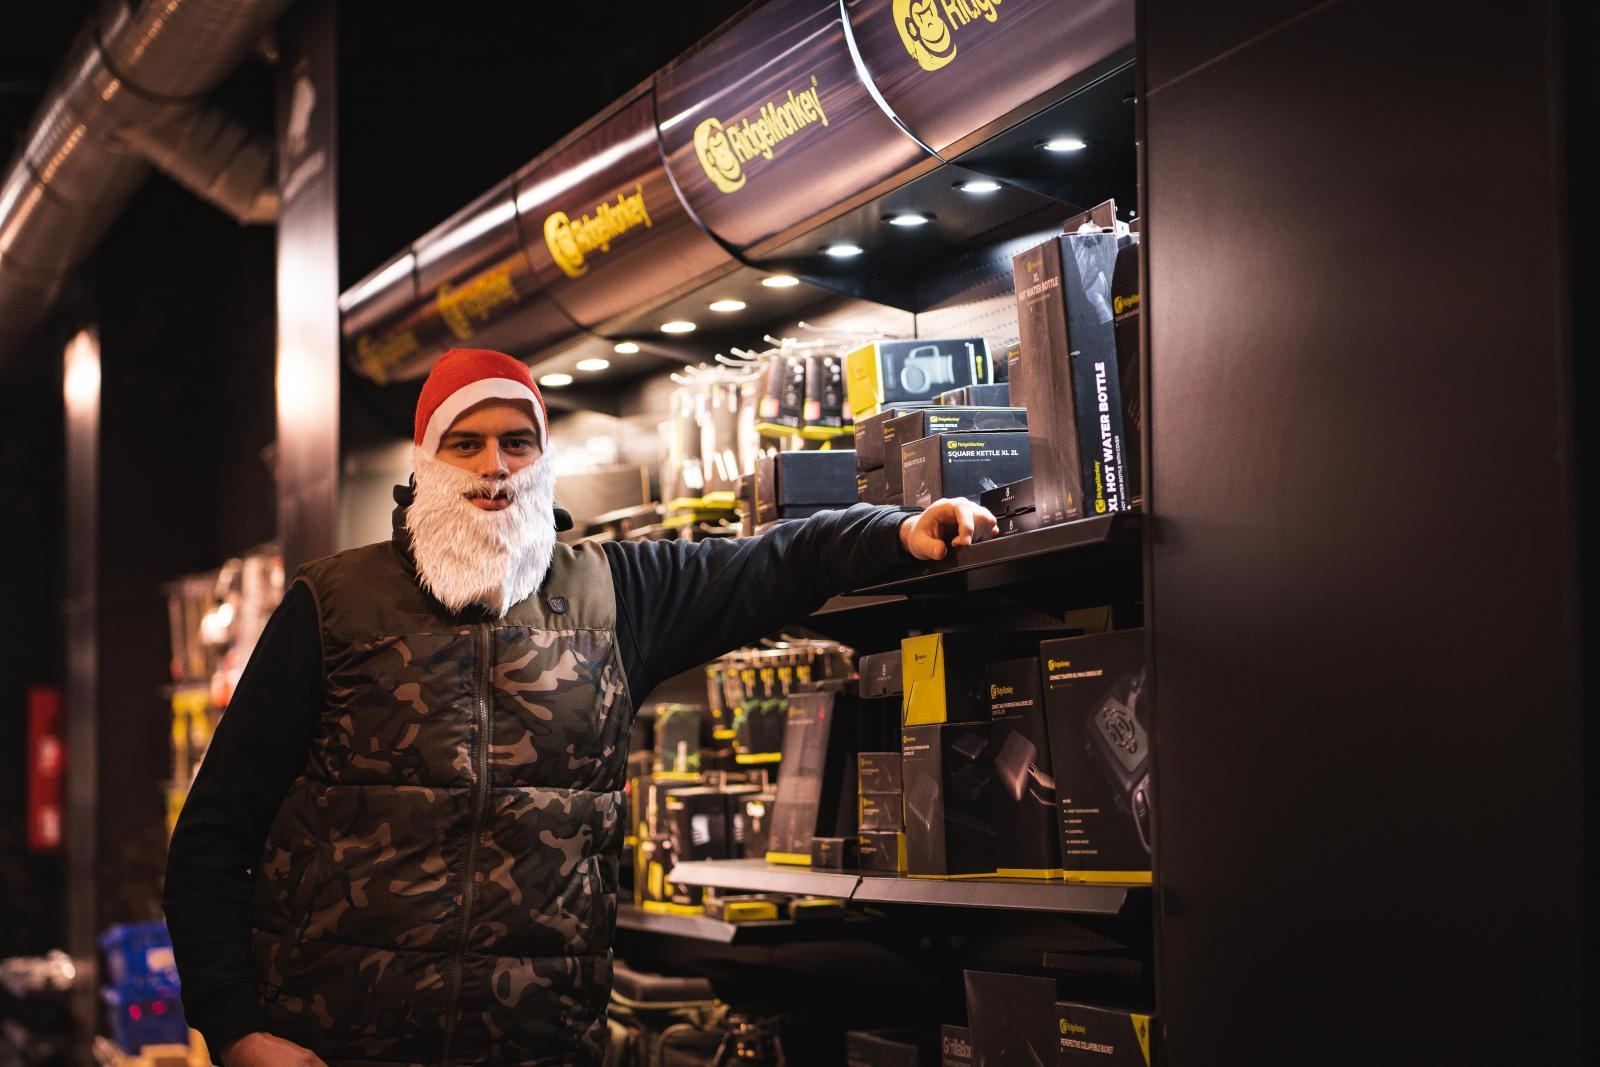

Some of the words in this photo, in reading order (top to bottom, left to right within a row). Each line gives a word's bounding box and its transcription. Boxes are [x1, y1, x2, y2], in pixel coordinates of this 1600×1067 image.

[941, 0, 1002, 31] Ridg
[726, 86, 829, 163] RidgeMonkey
[1042, 277, 1059, 291] BOTTLE
[1094, 361, 1109, 412] BOTTLE
[1100, 414, 1114, 463] WATER
[947, 450, 975, 459] SQUARE
[1105, 465, 1118, 493] HOT
[1107, 494, 1119, 512] XL
